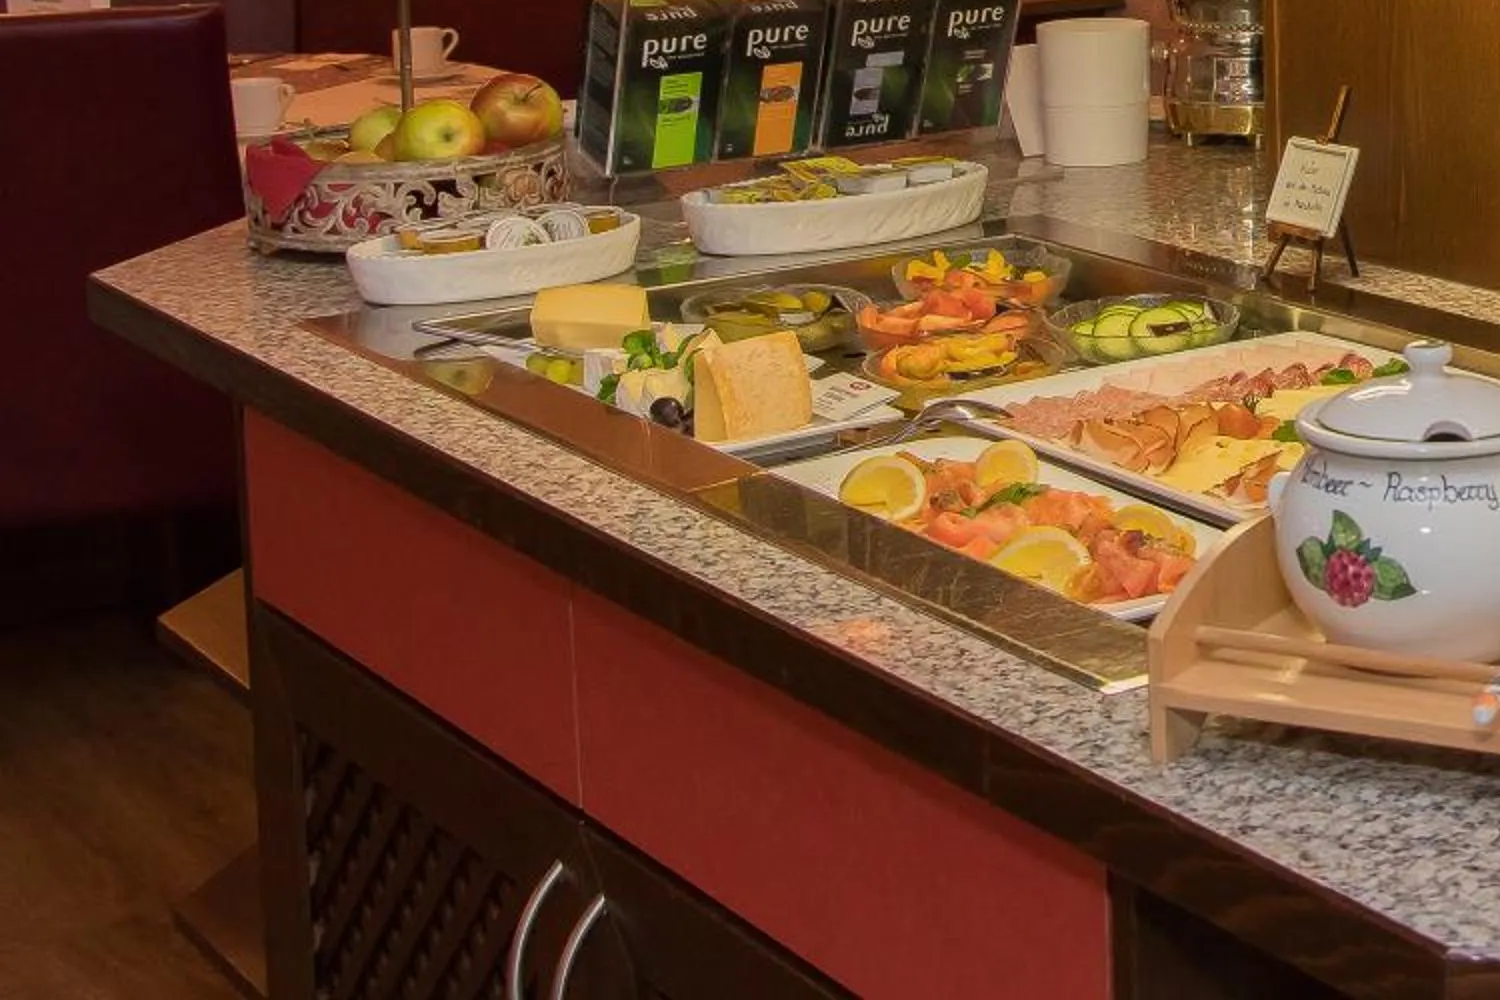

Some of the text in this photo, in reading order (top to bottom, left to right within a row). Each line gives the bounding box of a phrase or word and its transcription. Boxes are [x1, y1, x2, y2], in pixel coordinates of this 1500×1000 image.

[851, 13, 911, 47] pure
[947, 5, 1005, 38] pure
[641, 32, 708, 69] pure
[746, 23, 809, 57] pure
[1383, 471, 1500, 511] Raspberry
